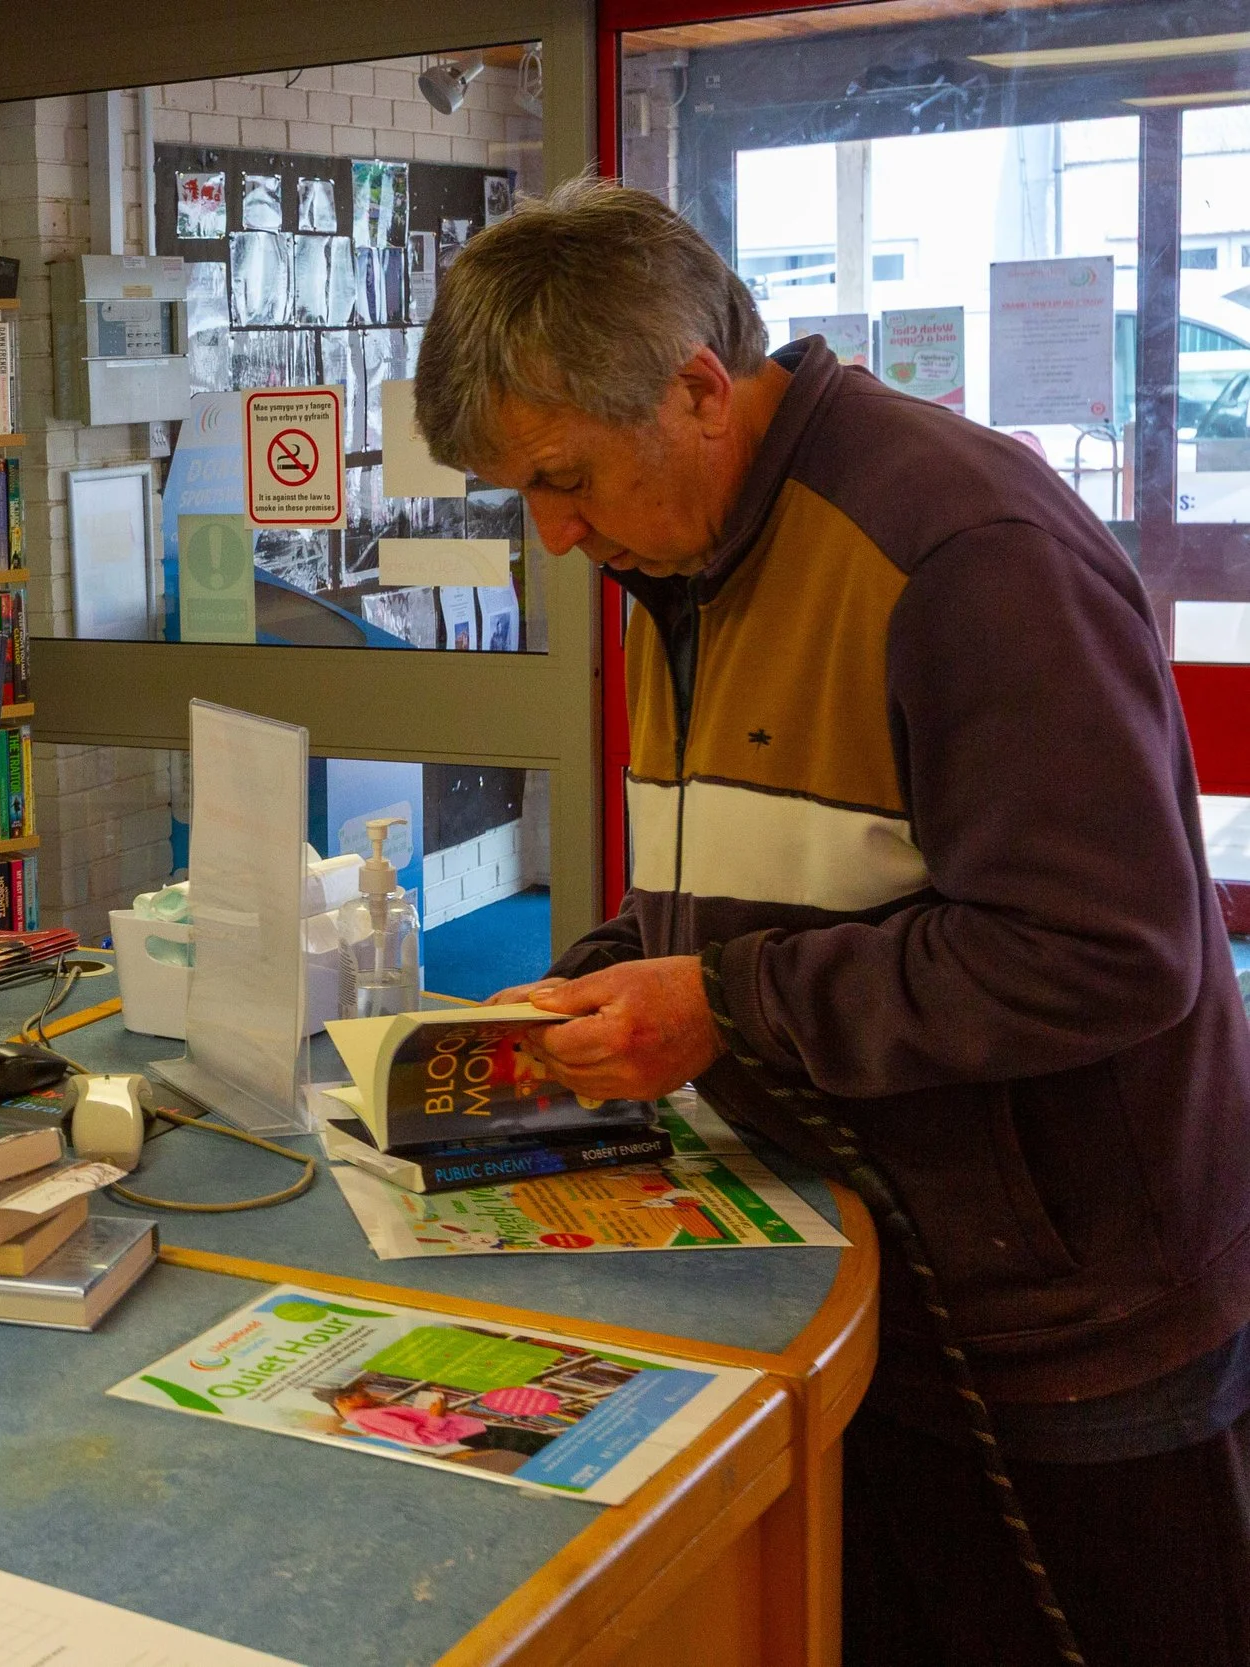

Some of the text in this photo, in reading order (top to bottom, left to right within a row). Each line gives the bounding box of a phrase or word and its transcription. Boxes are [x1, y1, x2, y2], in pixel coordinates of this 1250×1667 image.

[0, 348, 9, 375] FRENCH
[270, 403, 294, 413] ysmygu
[296, 403, 303, 411] yn
[305, 403, 309, 411] y
[310, 402, 332, 411] fangre
[279, 414, 298, 422] erbyn
[304, 413, 330, 422] gyfraith
[258, 493, 264, 501] It
[265, 493, 271, 501] is
[272, 493, 297, 502] against
[305, 504, 335, 513] premises
[9, 734, 21, 794] THE TRAITOR
[425, 1028, 476, 1114] BLOOD
[581, 1141, 661, 1161] ROBERT ENRIGHT
[435, 1156, 532, 1183] PUBLIC ENEMY
[207, 1353, 297, 1400] Quiet
[274, 1316, 354, 1355] Hour
